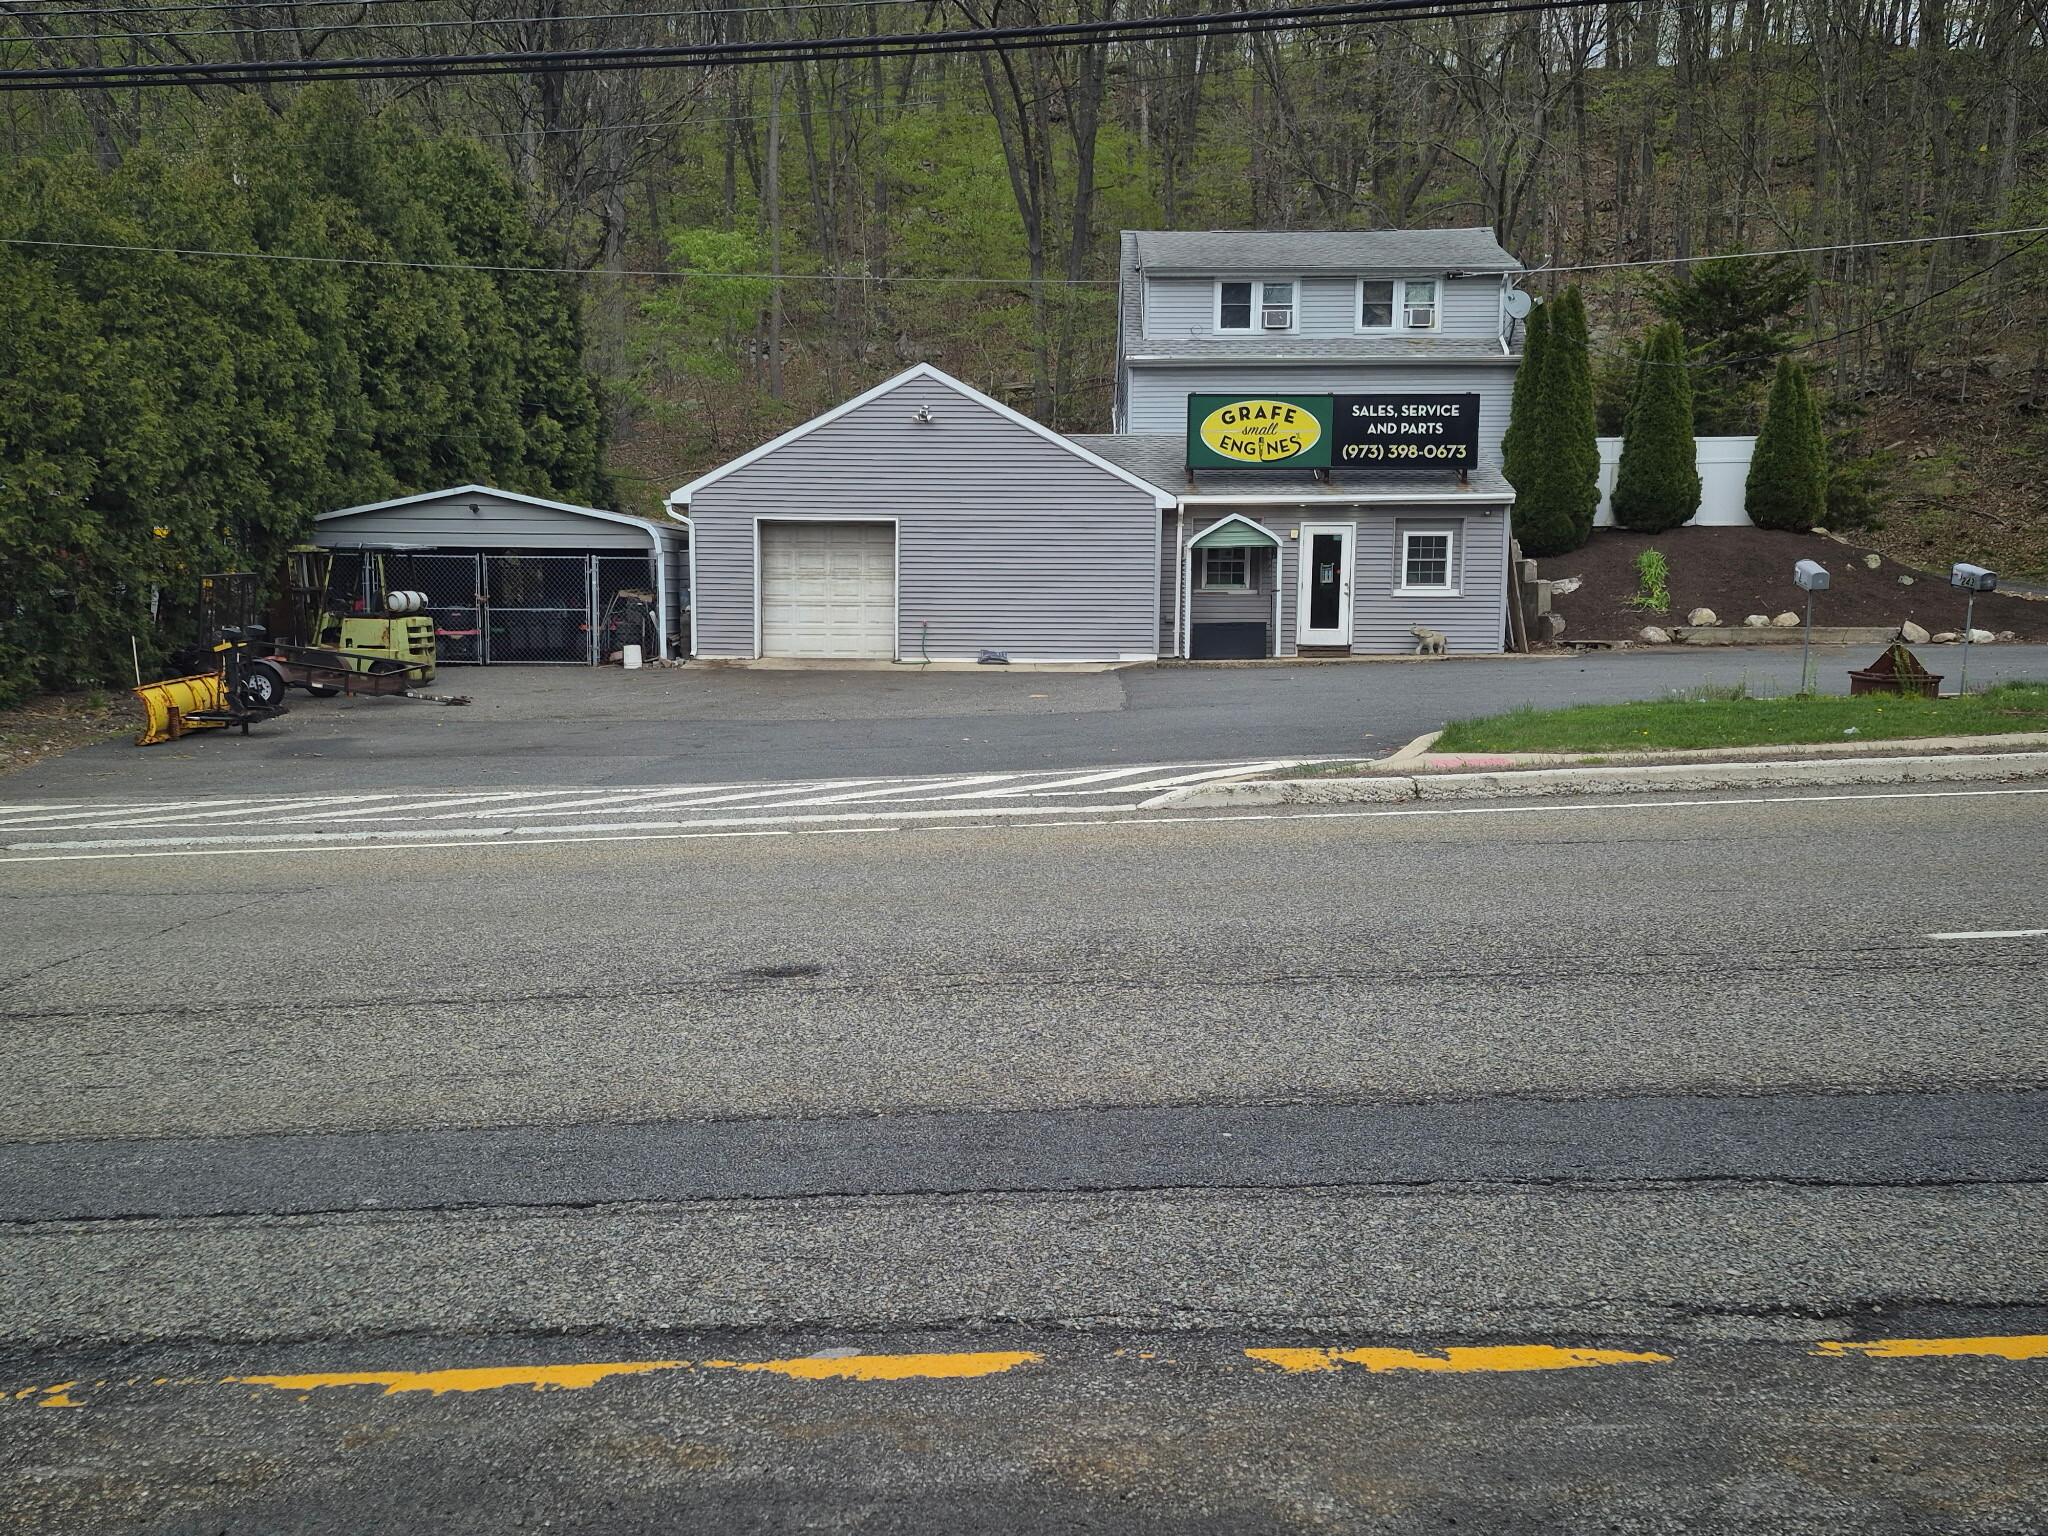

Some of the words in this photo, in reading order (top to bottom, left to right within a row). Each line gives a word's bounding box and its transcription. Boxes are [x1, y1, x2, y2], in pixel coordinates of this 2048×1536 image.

[1221, 405, 1297, 424] GRAFE
[1352, 405, 1398, 418] SALES,
[1401, 405, 1460, 417] SERVICE
[1242, 422, 1278, 435] small
[1367, 422, 1397, 434] AND
[1400, 422, 1444, 434] PARTS
[1219, 435, 1302, 462] ENGINES
[1342, 444, 1384, 460] (973)
[1387, 444, 1467, 459] 398-0673
